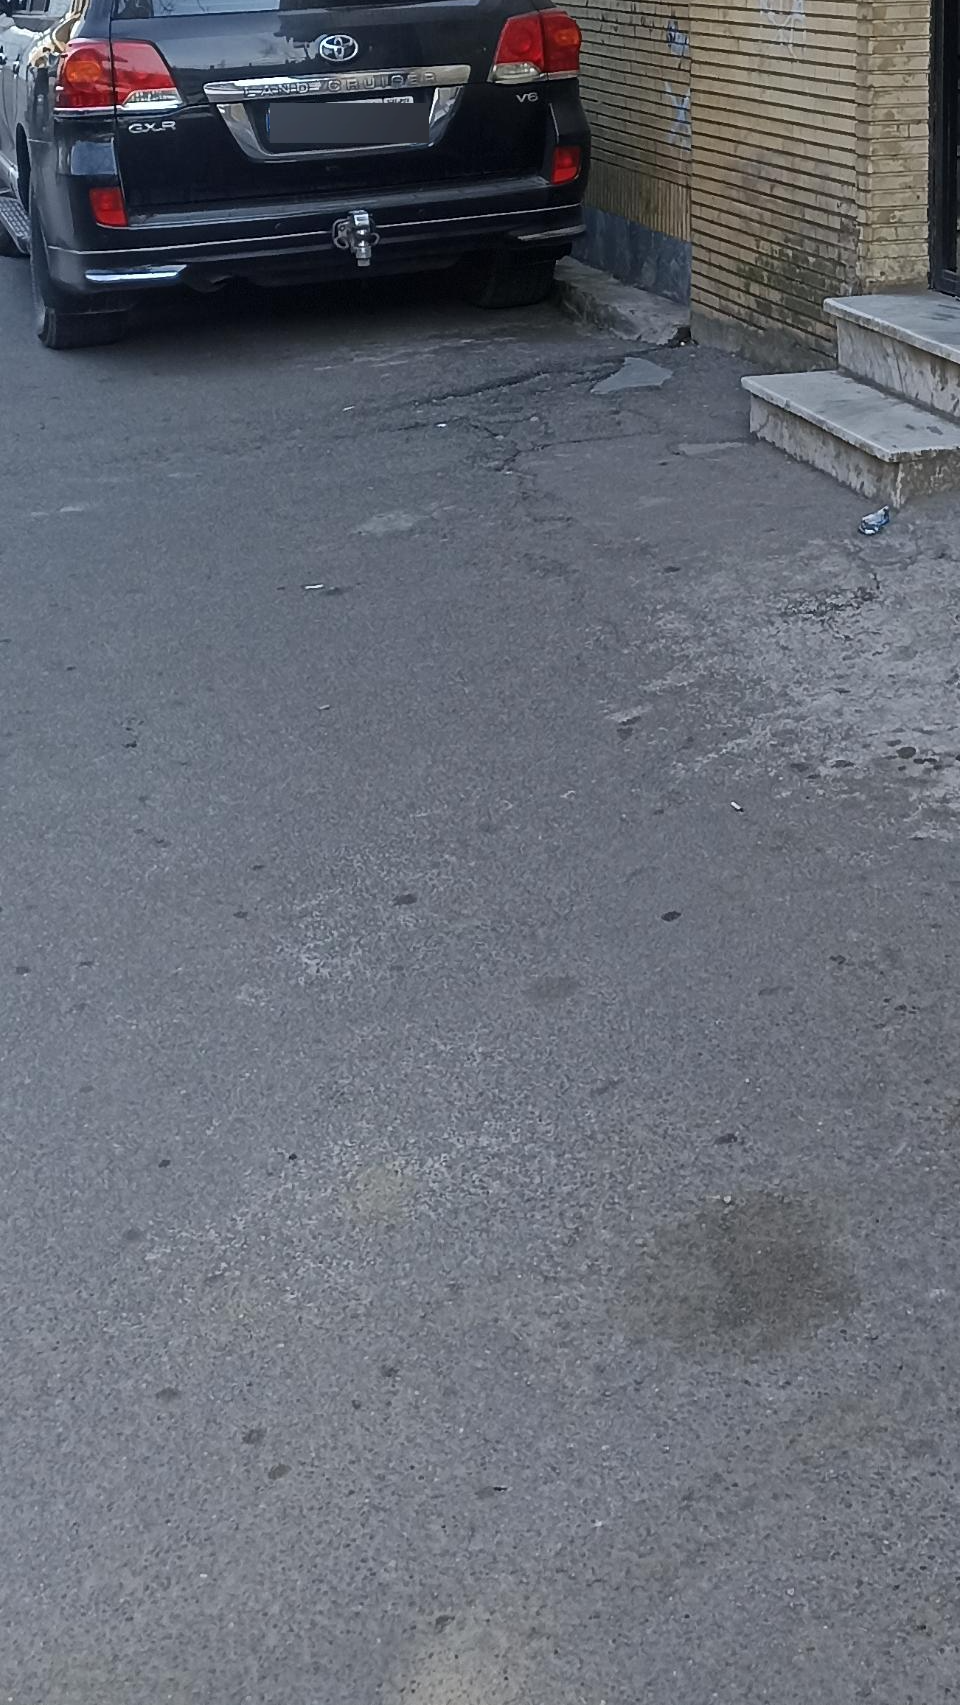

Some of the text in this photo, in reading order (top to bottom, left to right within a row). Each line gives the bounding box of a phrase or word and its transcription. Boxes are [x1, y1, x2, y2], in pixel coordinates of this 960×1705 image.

[244, 72, 438, 98] LAND CRUISER
[515, 92, 538, 103] V6
[128, 120, 176, 134] GXR
